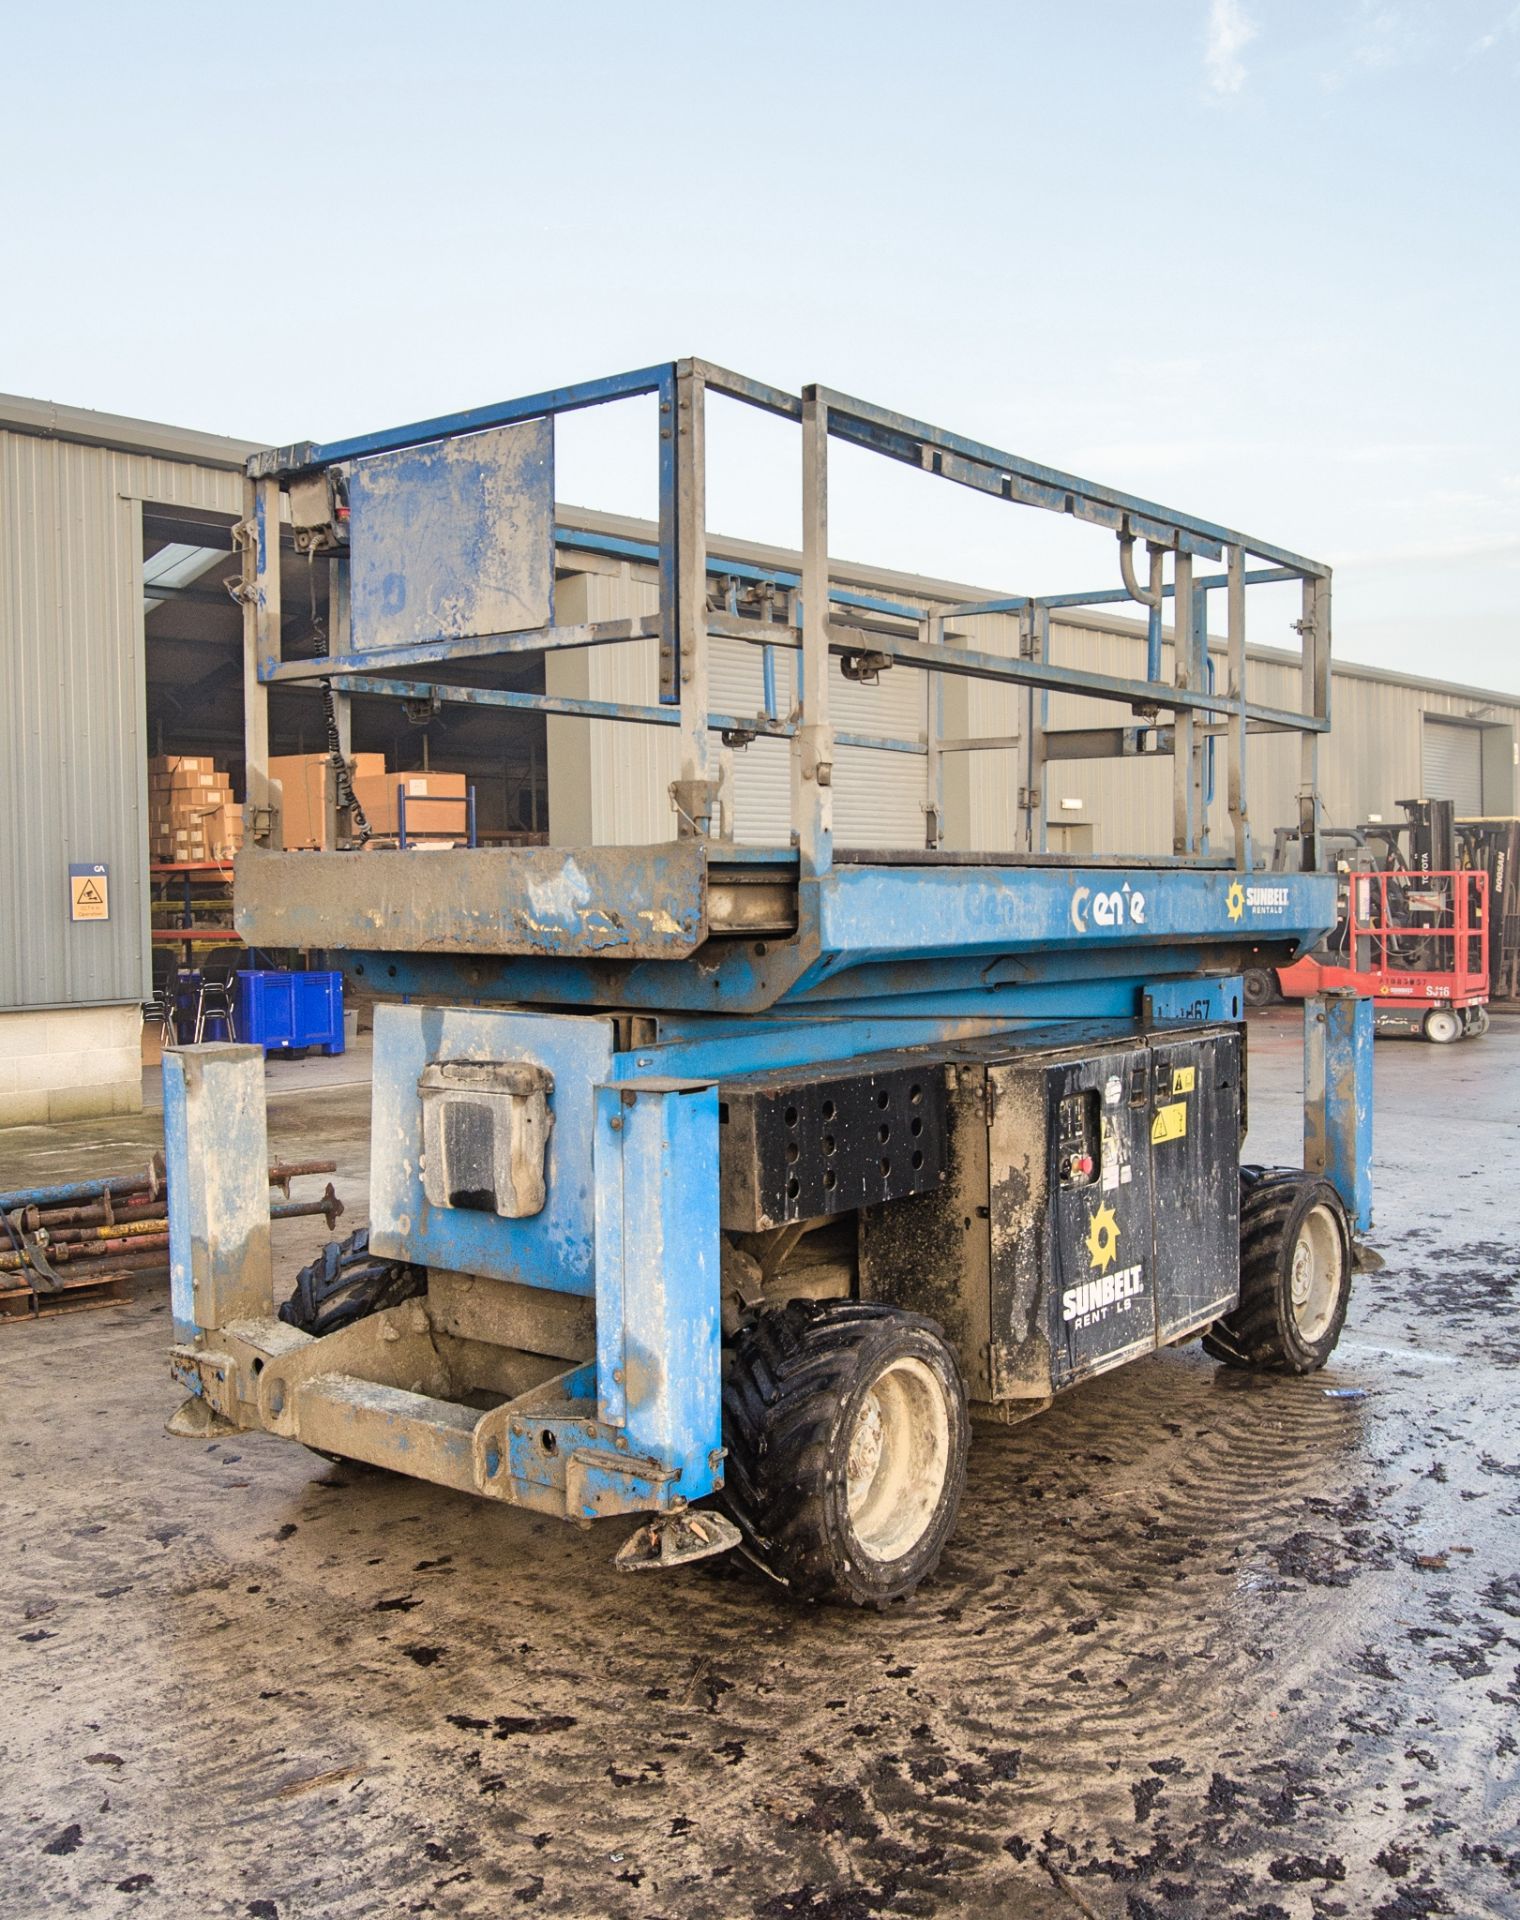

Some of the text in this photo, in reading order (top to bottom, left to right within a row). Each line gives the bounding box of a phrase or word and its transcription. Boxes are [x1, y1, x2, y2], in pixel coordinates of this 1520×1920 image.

[1496, 851, 1505, 892] DOOSAN
[1246, 887, 1290, 906] SUNBELT
[1426, 985, 1450, 997] SJ16
[1062, 1264, 1144, 1322] SUNBELT
[1074, 1298, 1132, 1330] RENTLS
